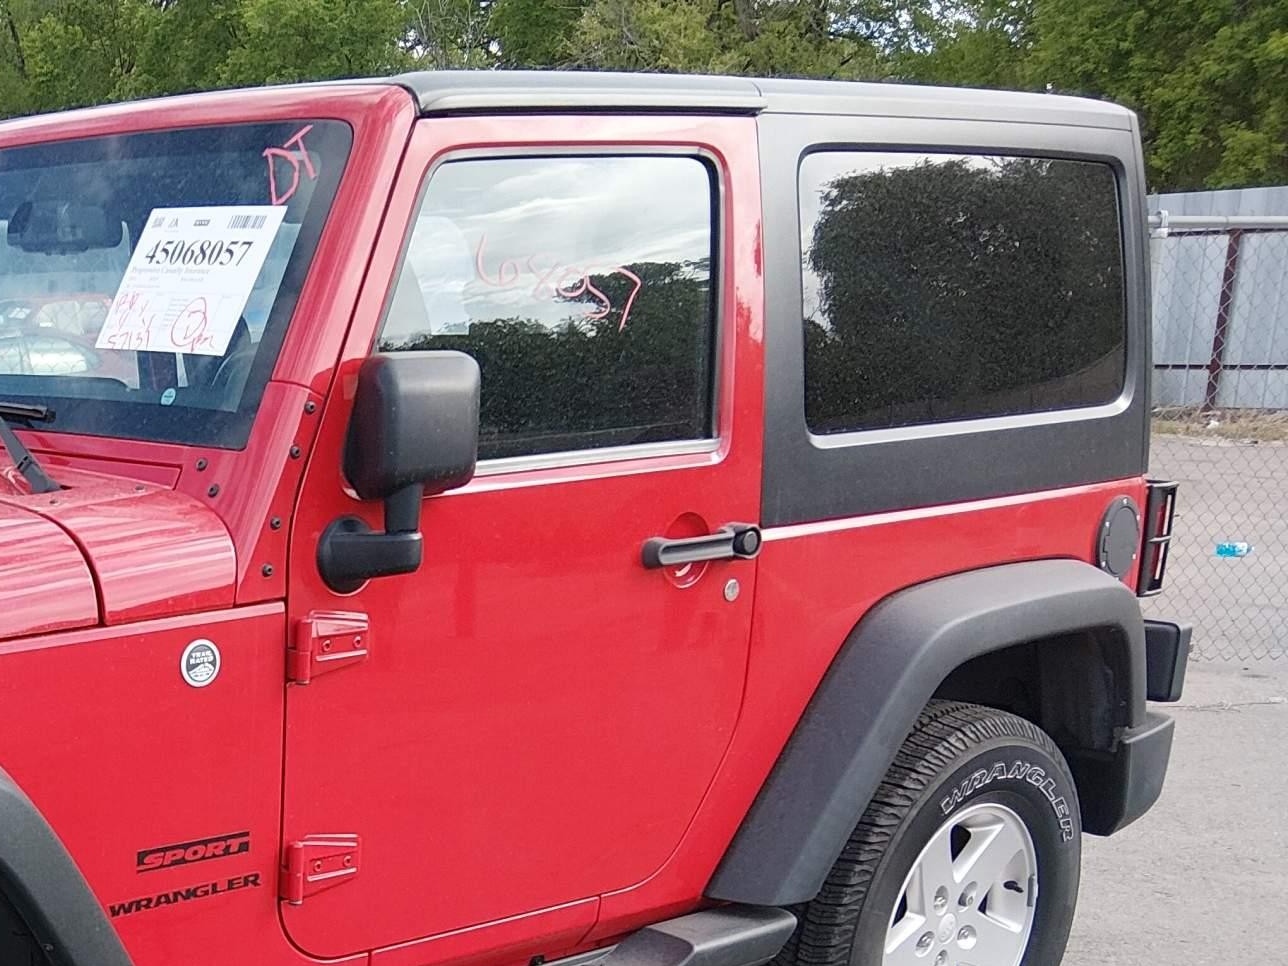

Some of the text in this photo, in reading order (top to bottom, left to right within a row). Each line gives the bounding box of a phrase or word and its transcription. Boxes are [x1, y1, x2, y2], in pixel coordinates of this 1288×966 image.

[145, 239, 254, 267] 45068057
[940, 760, 1074, 843] WRANGLER
[138, 836, 250, 870] SPORT
[109, 872, 261, 918] WRANGLER
